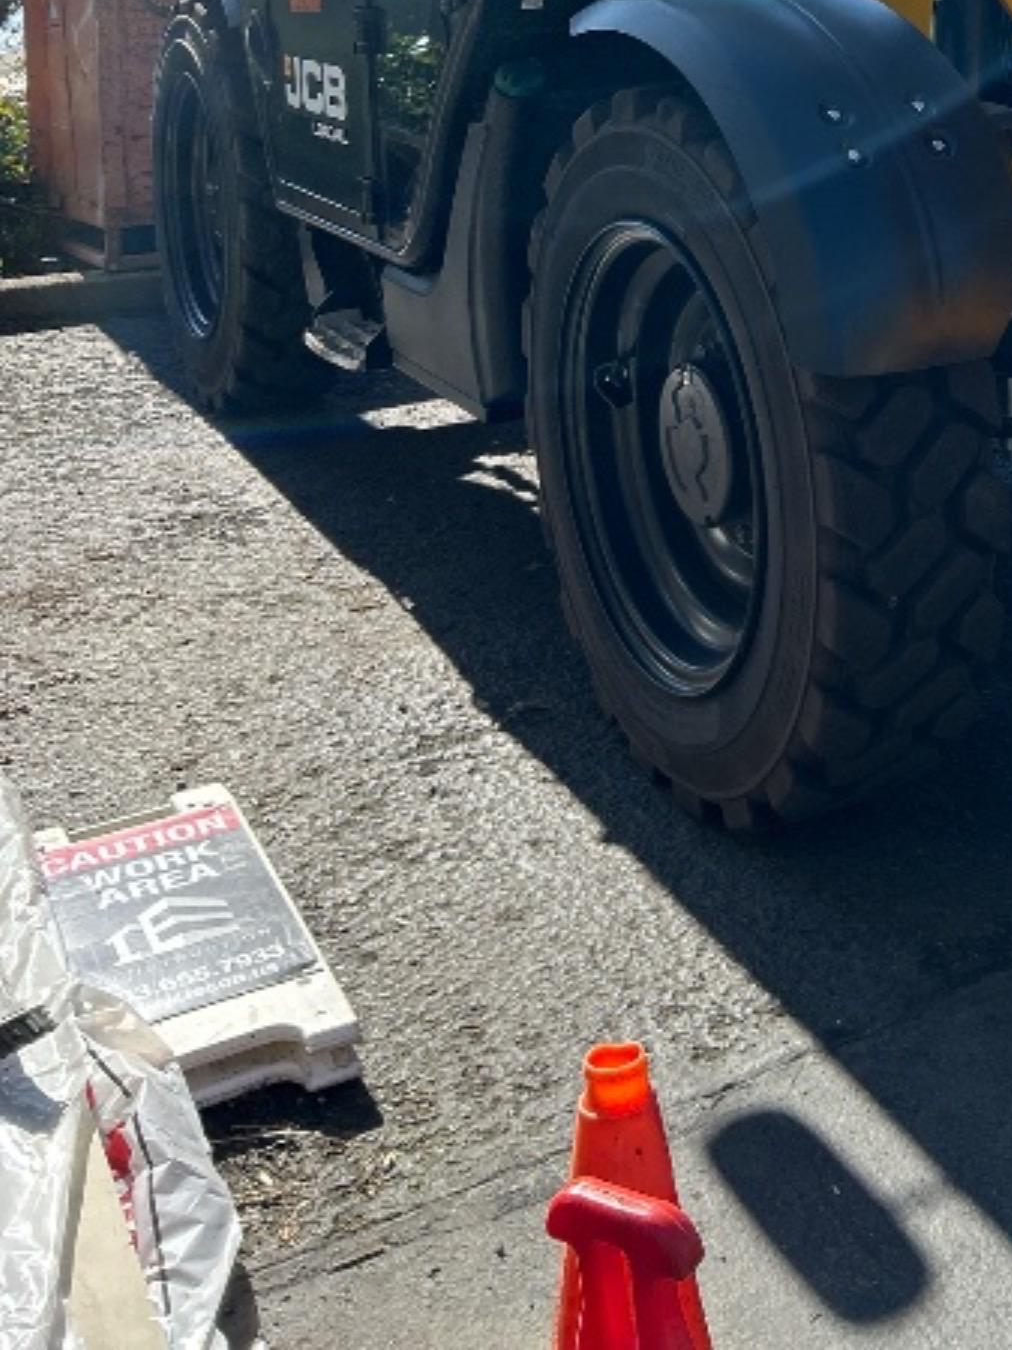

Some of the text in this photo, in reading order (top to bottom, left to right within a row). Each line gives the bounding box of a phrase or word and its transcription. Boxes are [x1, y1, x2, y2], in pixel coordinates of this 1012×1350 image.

[284, 55, 347, 122] JCB
[40, 814, 227, 878] CAUTION
[78, 839, 219, 891] WORK
[97, 862, 221, 910] AREA
